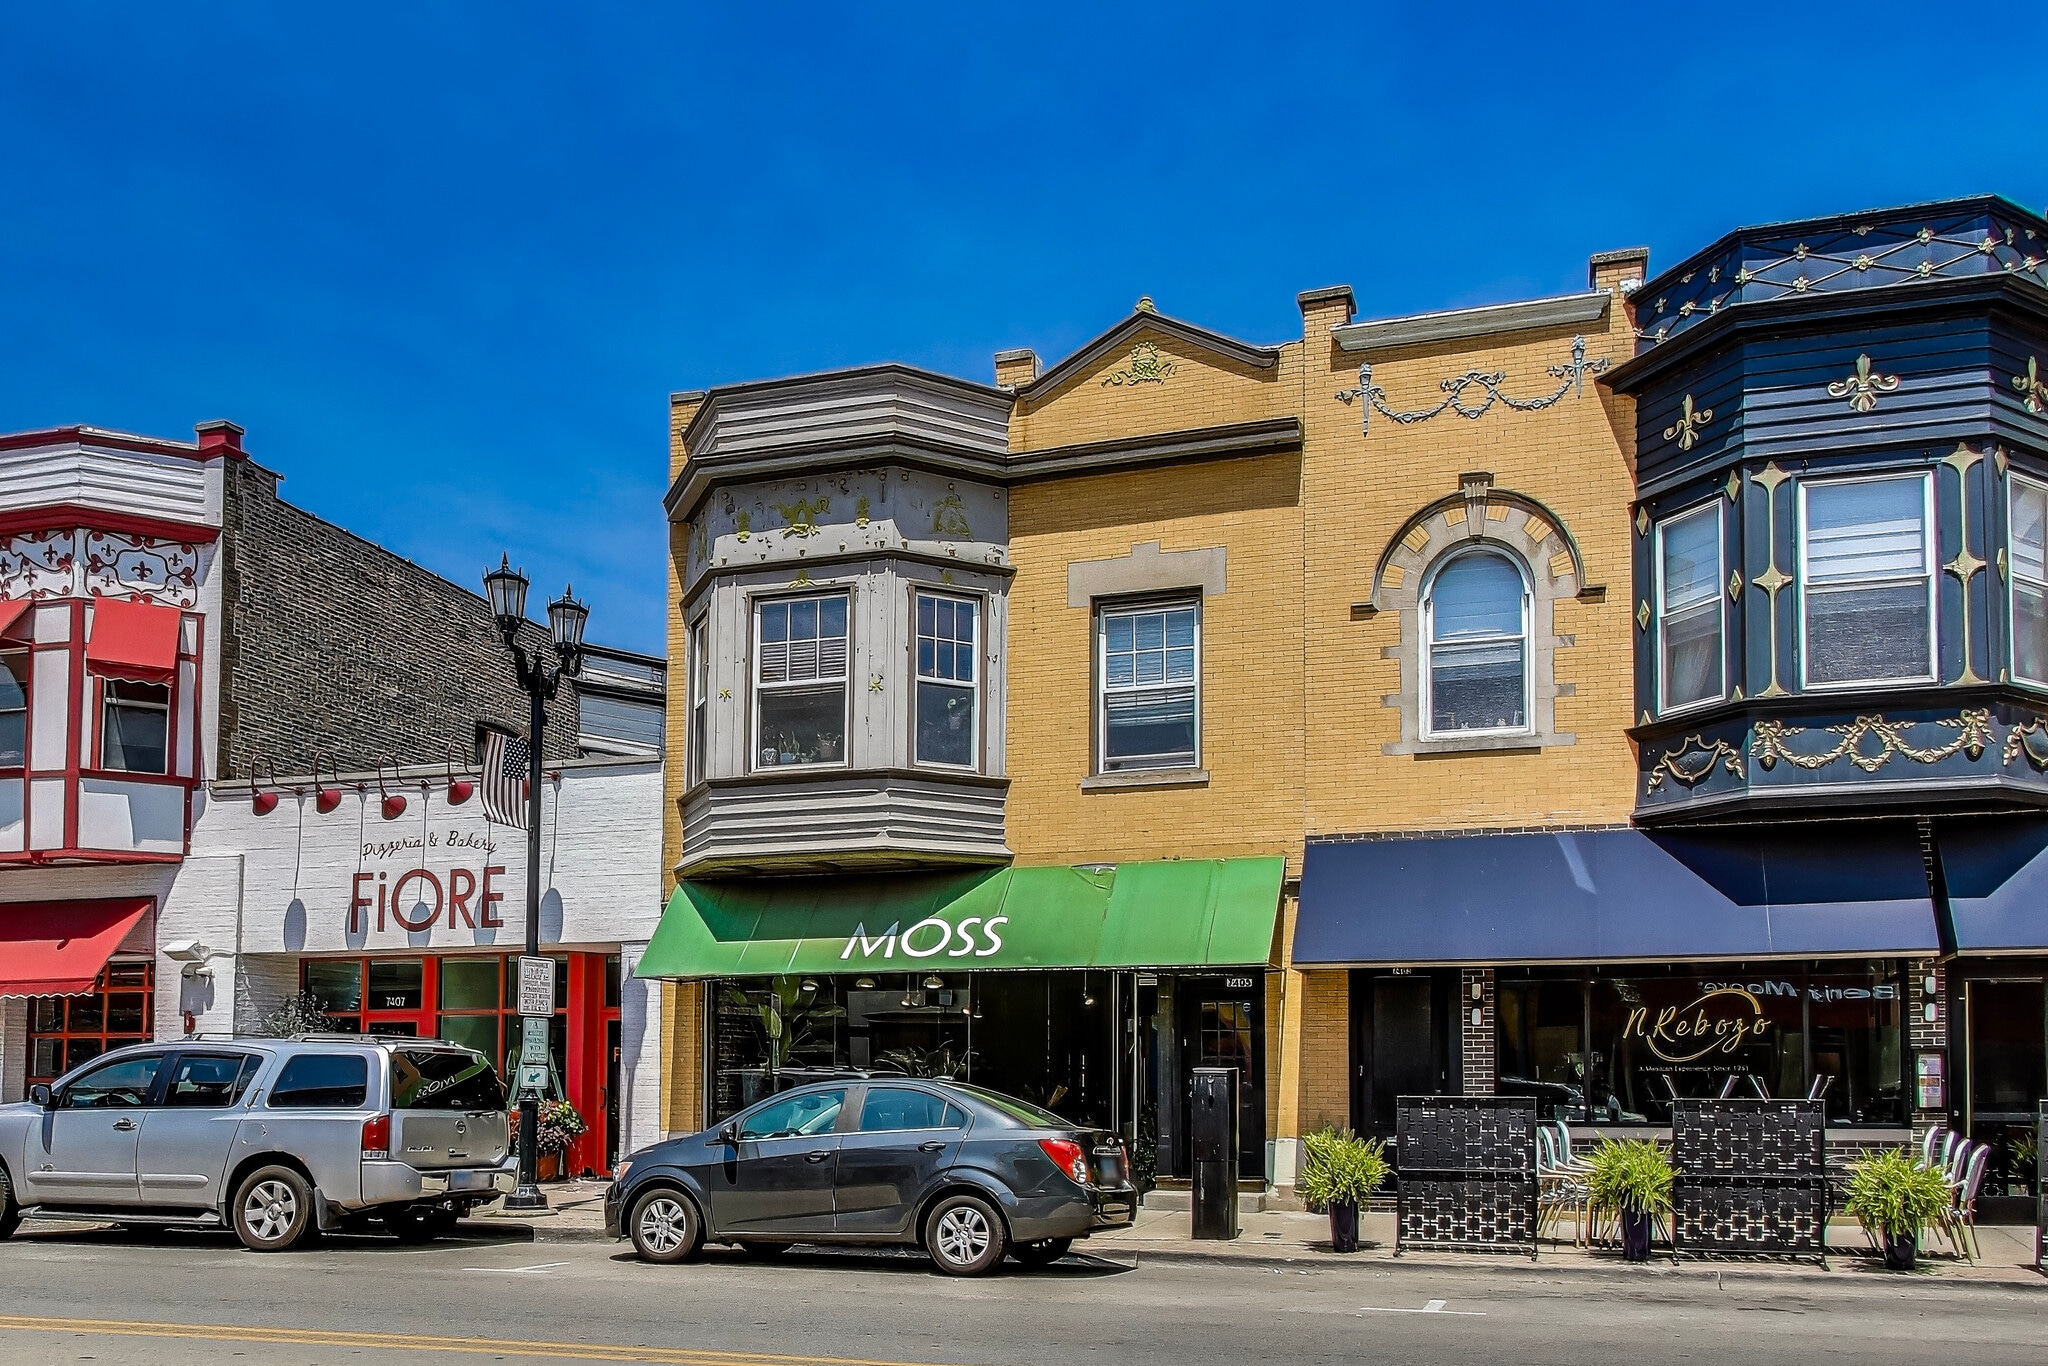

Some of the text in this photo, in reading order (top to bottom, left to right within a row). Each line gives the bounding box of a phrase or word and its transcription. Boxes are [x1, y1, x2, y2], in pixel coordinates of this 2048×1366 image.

[429, 832, 438, 846] &
[446, 831, 497, 855] Bakery
[839, 916, 1009, 960] MOSS
[385, 996, 406, 1007] 7407
